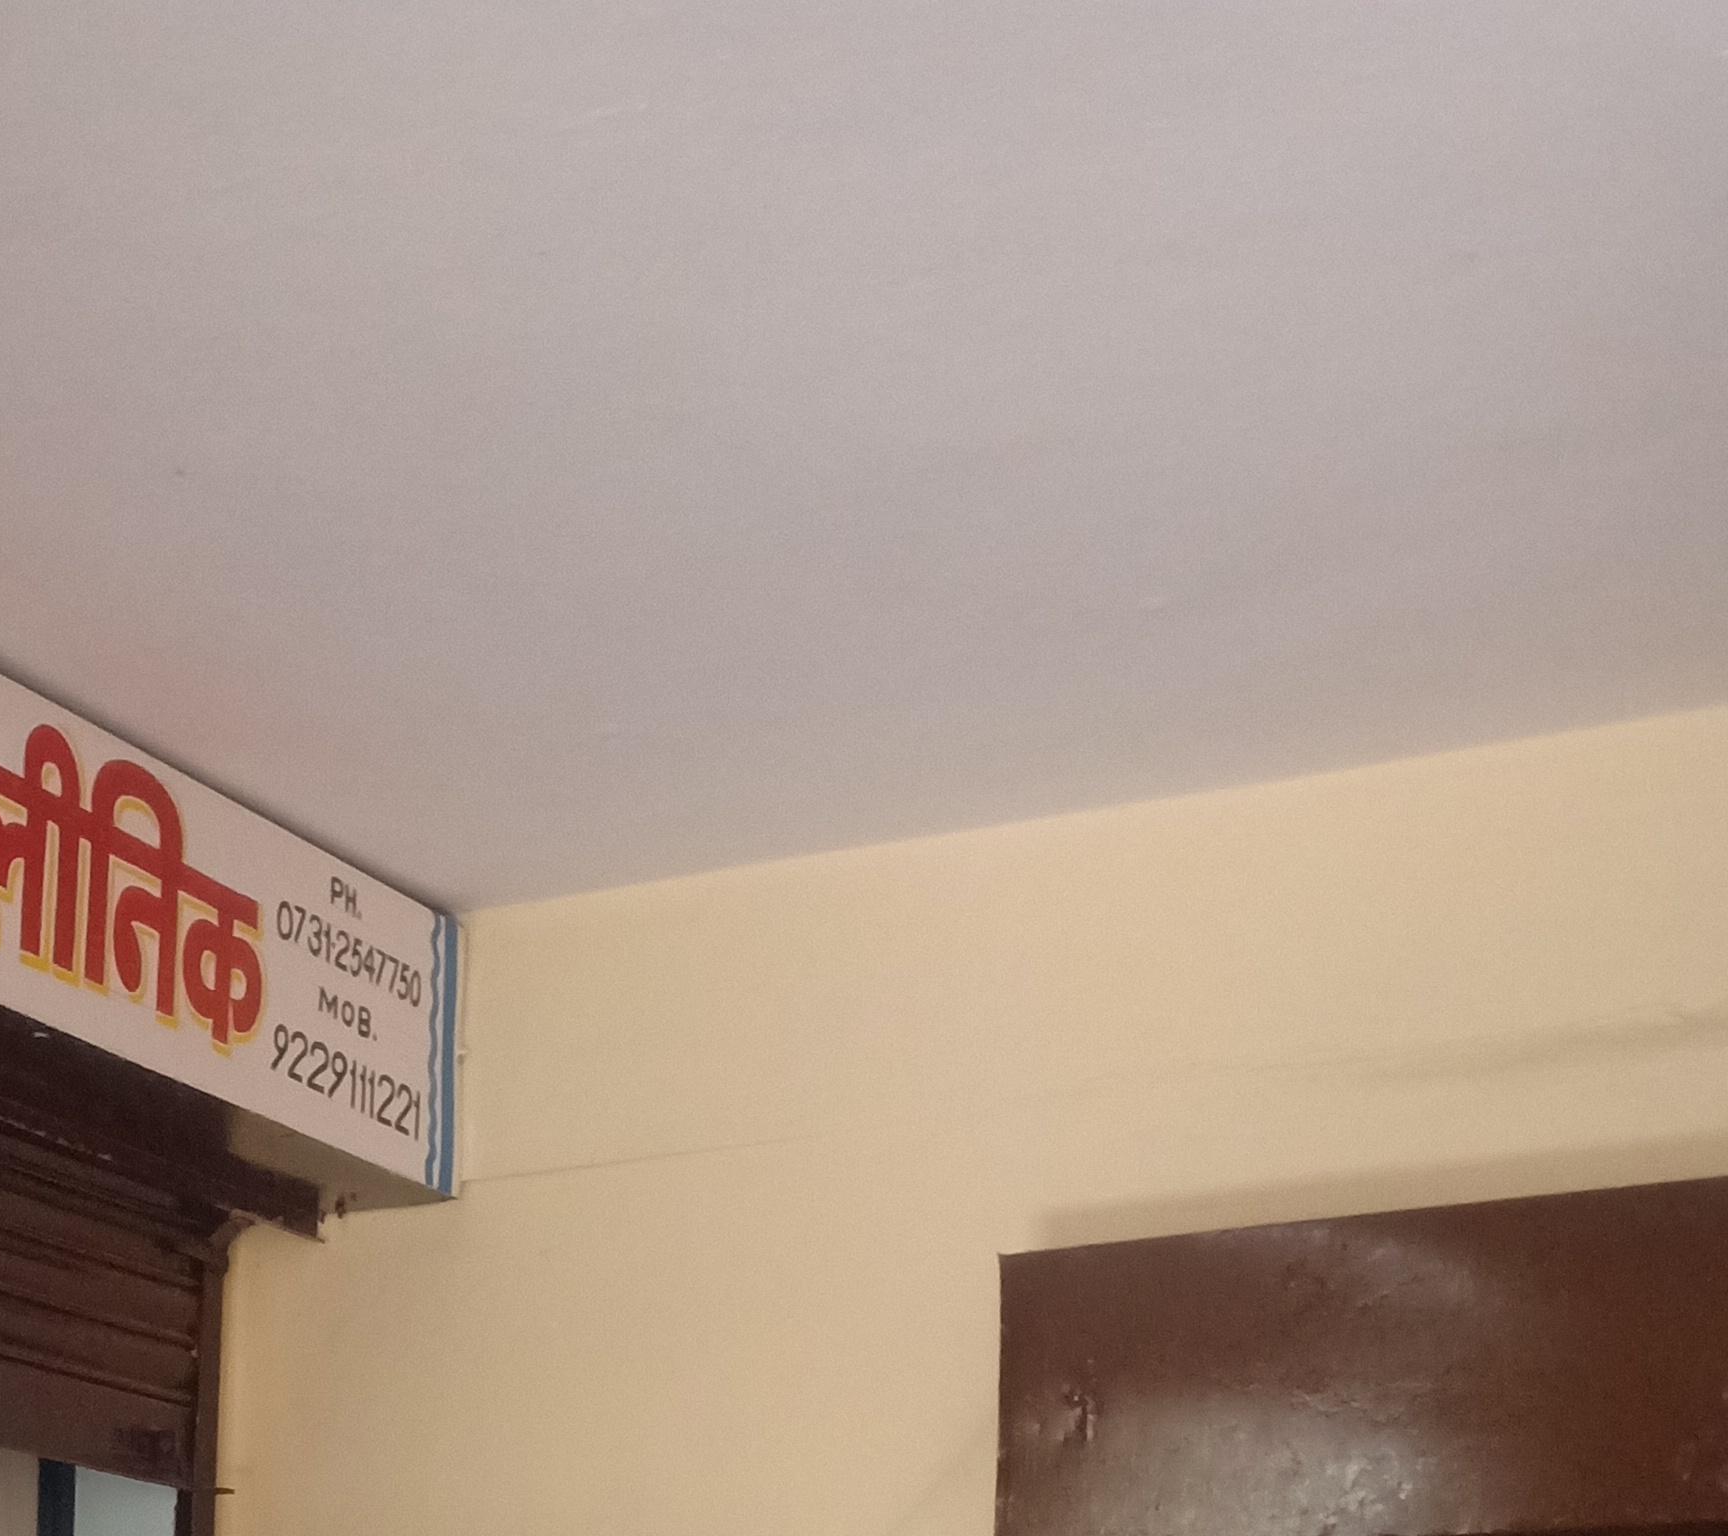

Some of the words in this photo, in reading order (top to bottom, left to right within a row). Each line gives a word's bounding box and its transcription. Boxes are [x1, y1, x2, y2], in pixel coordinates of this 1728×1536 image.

[330, 876, 361, 918] PH.
[318, 986, 377, 1041] MOB.
[271, 1024, 420, 1141] 9229111221
